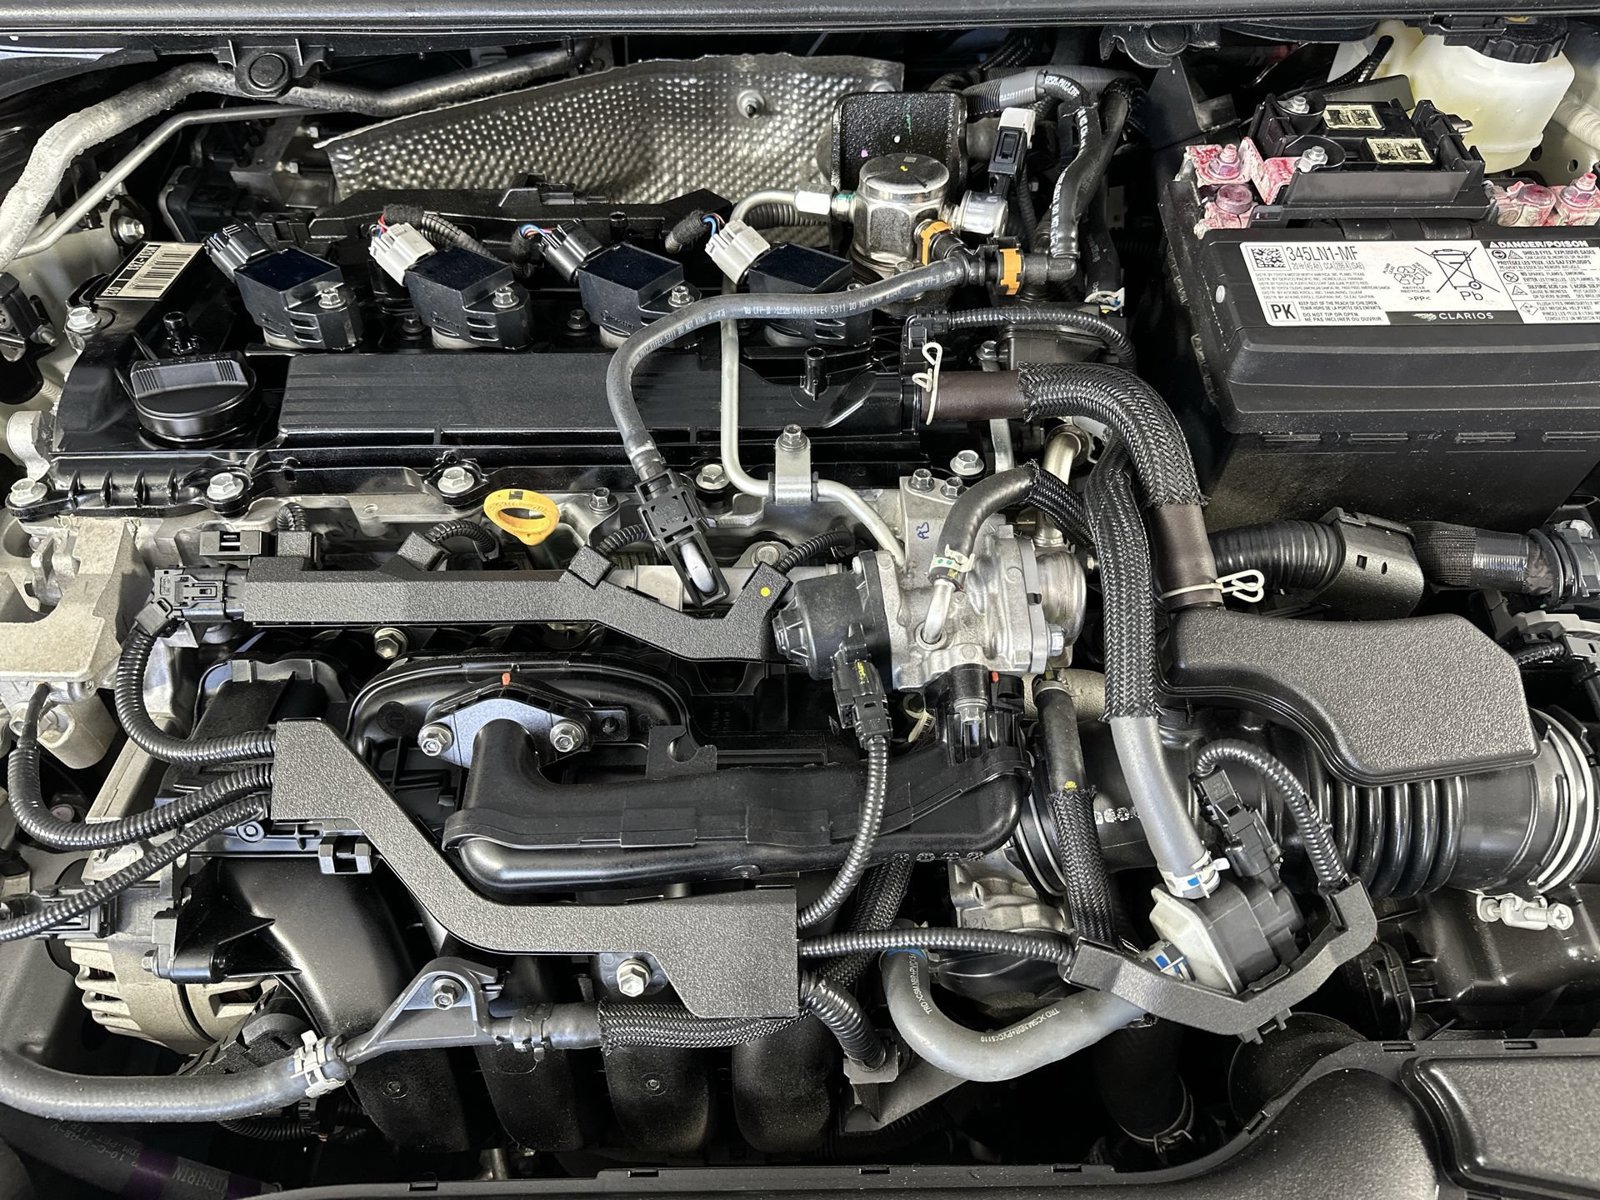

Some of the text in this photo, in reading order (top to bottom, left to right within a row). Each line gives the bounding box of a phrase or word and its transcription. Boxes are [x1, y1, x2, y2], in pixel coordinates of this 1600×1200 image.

[1497, 240, 1589, 248] DANGER/POISON
[1286, 246, 1357, 261] 345LN1-MF
[1459, 291, 1483, 301] Pb
[1271, 304, 1296, 320] PK
[1438, 312, 1494, 320] CLARIOS
